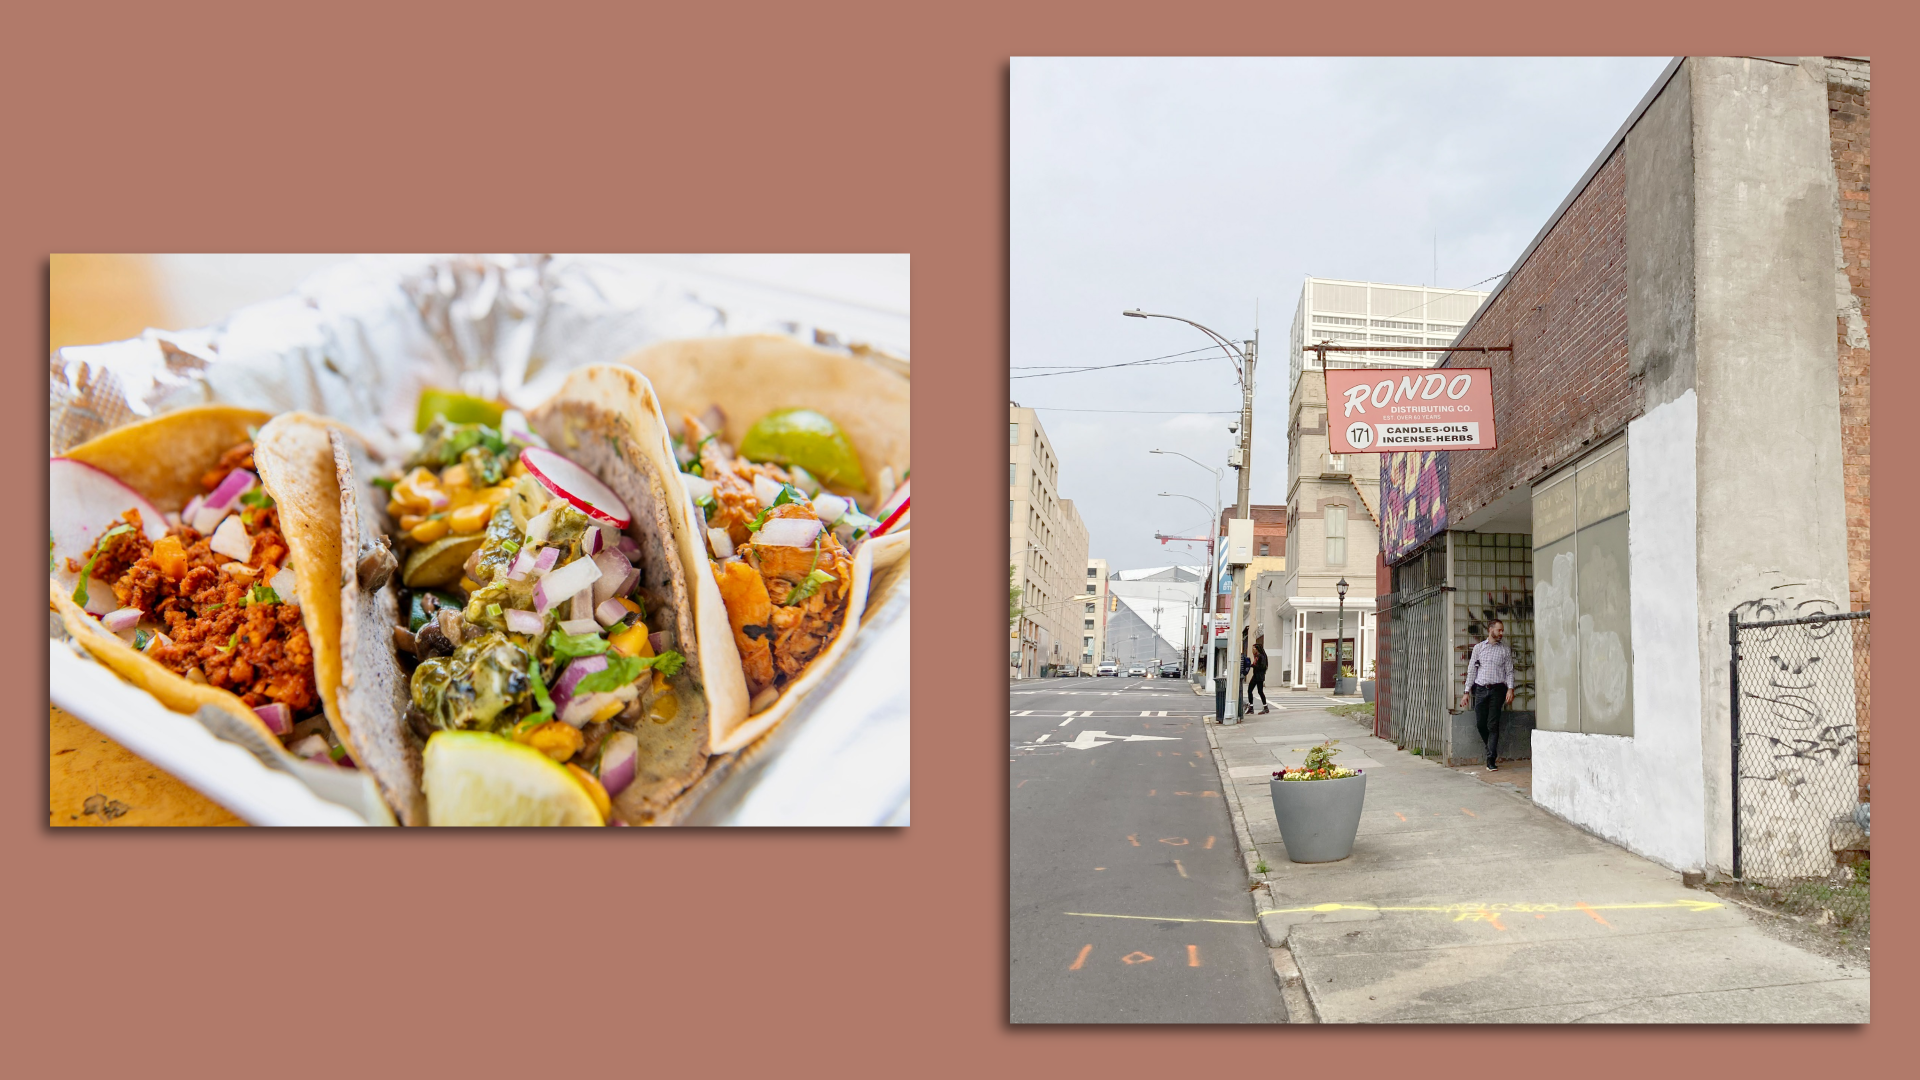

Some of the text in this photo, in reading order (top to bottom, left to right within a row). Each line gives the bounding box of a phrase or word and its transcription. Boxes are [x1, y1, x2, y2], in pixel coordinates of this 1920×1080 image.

[1343, 373, 1472, 418] RONDO
[1391, 405, 1455, 413] DISTRIBUTING
[1387, 425, 1469, 434] CANDLES-OILS
[1351, 427, 1370, 443] 171
[1382, 434, 1474, 443] INCENSE-HERBS
